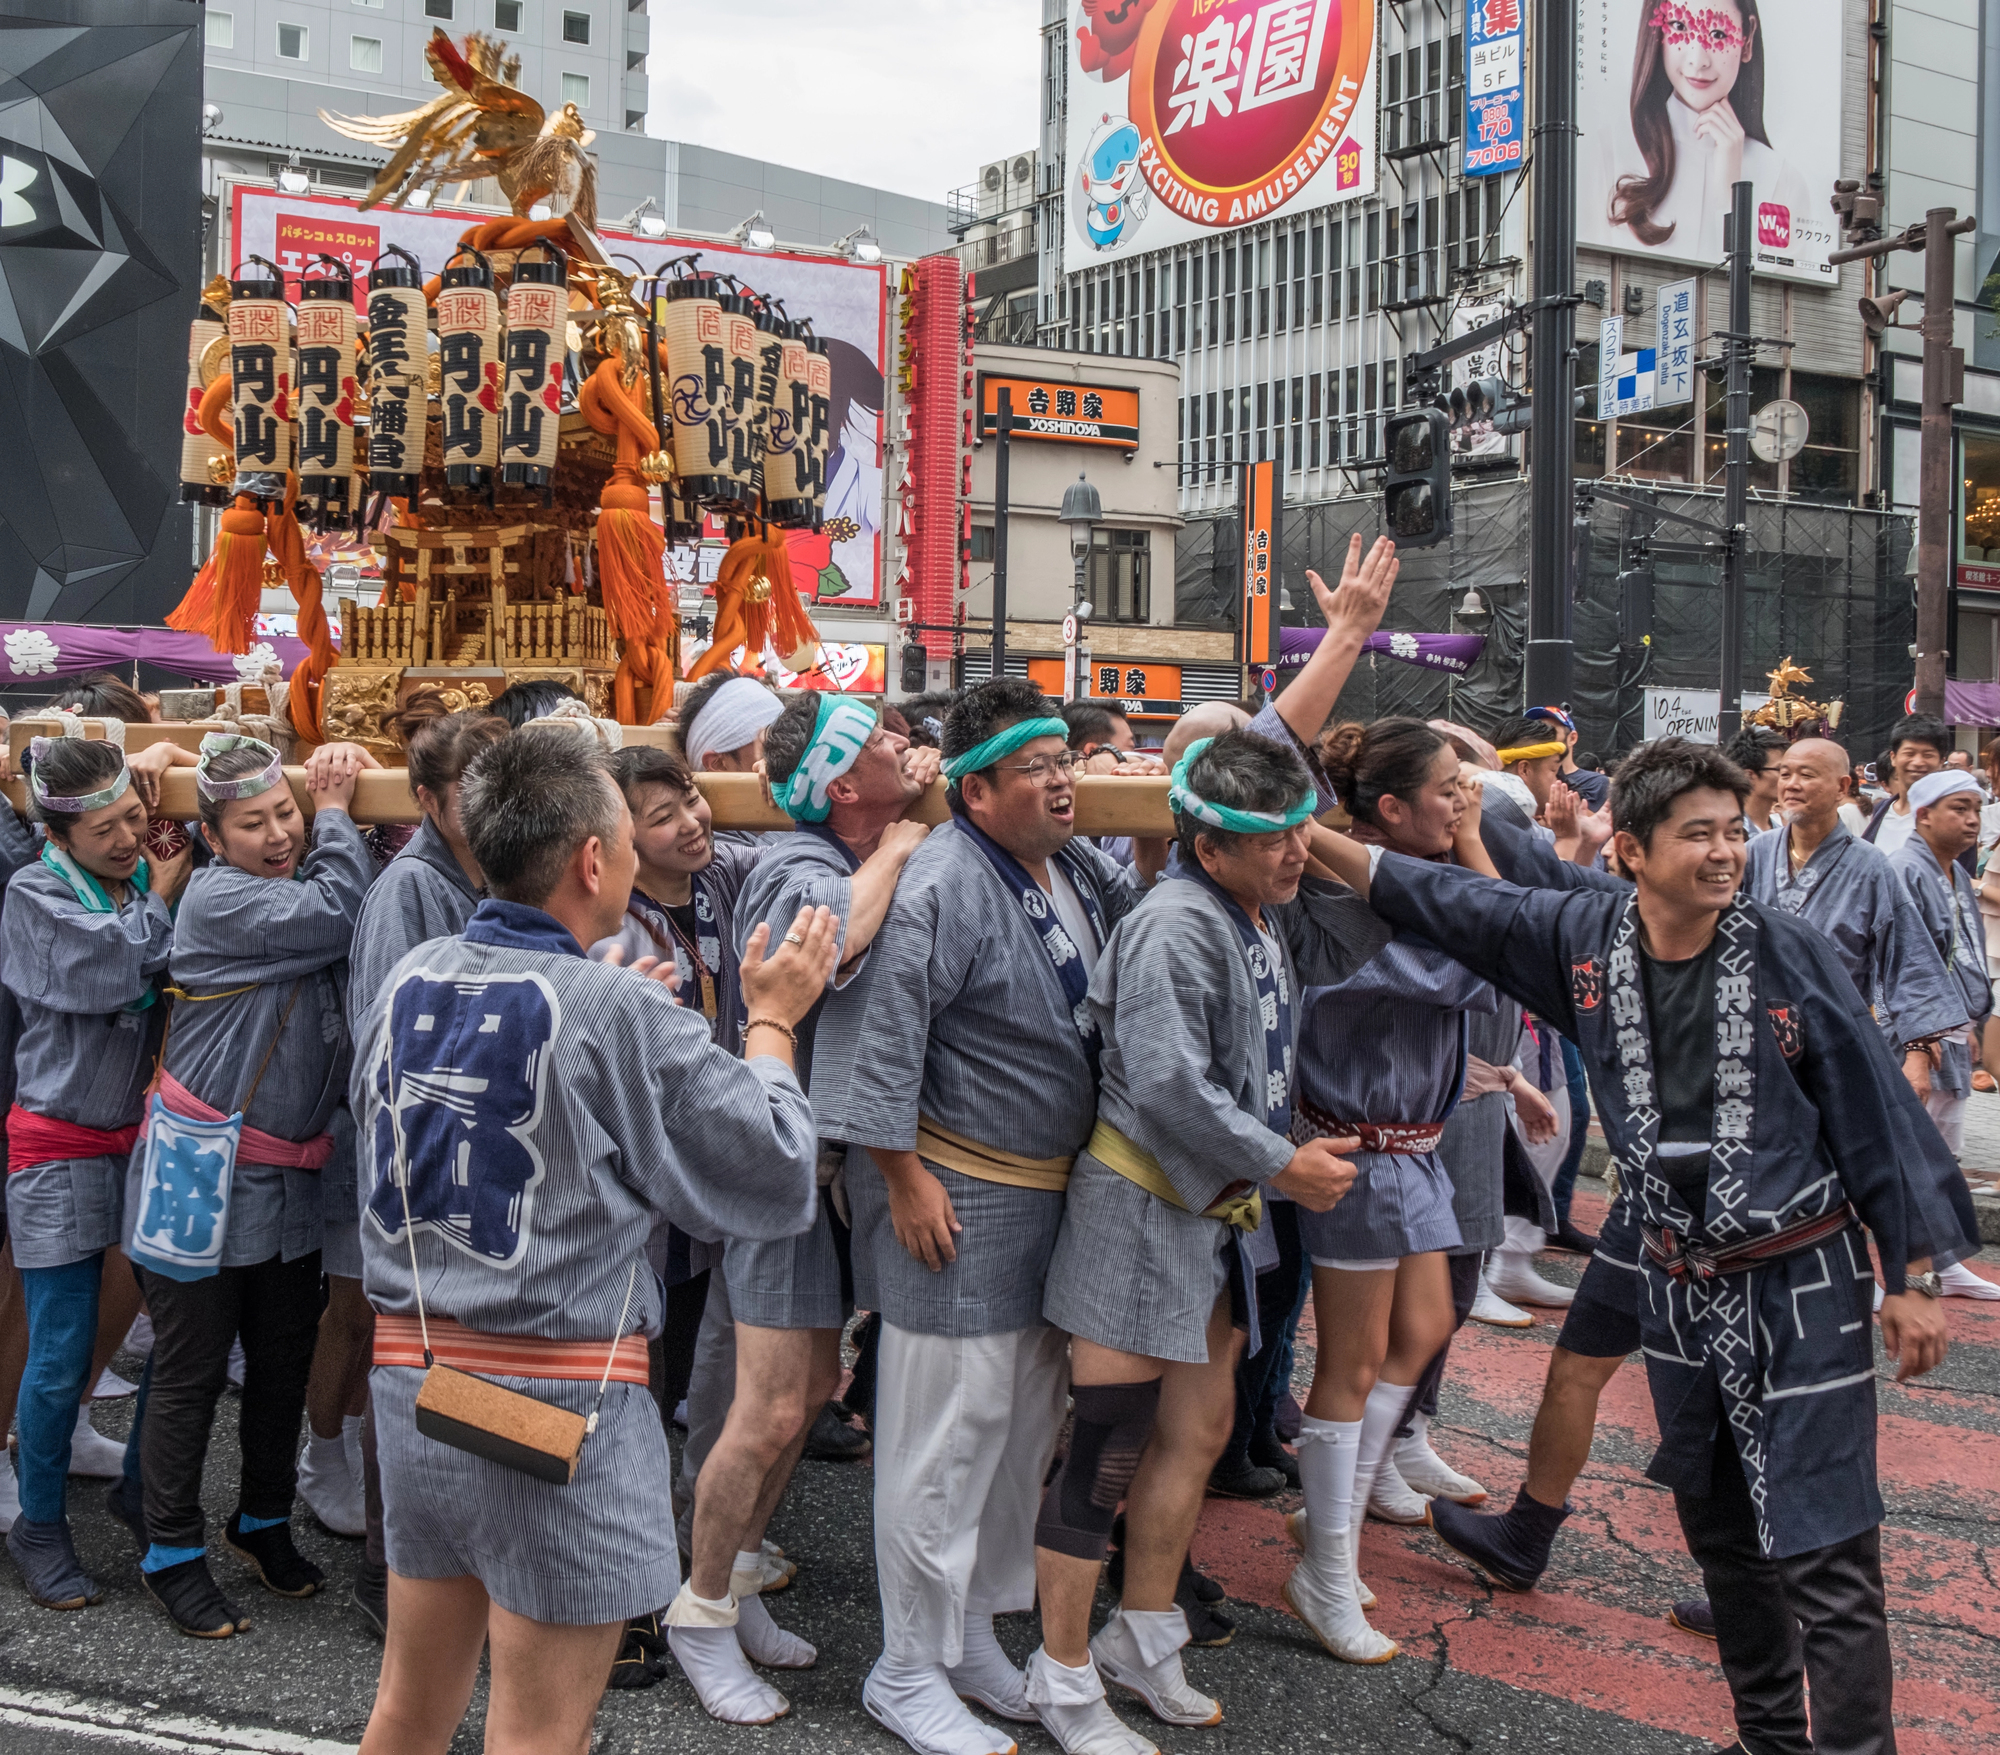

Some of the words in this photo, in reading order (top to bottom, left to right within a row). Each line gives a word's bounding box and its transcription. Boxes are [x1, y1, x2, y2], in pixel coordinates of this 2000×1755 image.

[1163, 0, 1331, 137] 楽園
[1475, 45, 1515, 66] 当ビル
[1470, 90, 1520, 112] フリーコール
[1482, 104, 1508, 122] 0800
[1478, 117, 1512, 142] 170
[1139, 136, 1219, 222] EXCITING
[1228, 75, 1358, 223] AMUSEMENT
[1338, 152, 1359, 172] 30
[1467, 140, 1521, 168] 7006
[1343, 171, 1354, 184] 秒
[1796, 229, 1831, 244] ワクワク
[1661, 305, 1671, 358] Dogenzaka
[1672, 290, 1690, 393] 道玄坂下
[1603, 322, 1617, 415] スクランブル式
[1661, 362, 1671, 386] shita
[231, 343, 277, 466] 円山
[298, 345, 341, 468] 円山
[441, 331, 484, 458] 円山
[503, 329, 551, 457] 円山
[1027, 386, 1103, 420] 吉野家
[1619, 396, 1652, 414] 時差式
[1029, 418, 1100, 437] YOSHINOYA
[1255, 529, 1269, 597] 吉野家
[1065, 619, 1073, 639] 3
[4, 629, 61, 676] 祭
[1389, 633, 1420, 659] 祭
[1089, 666, 1146, 695] 野家
[1653, 696, 1682, 720] 10.4
